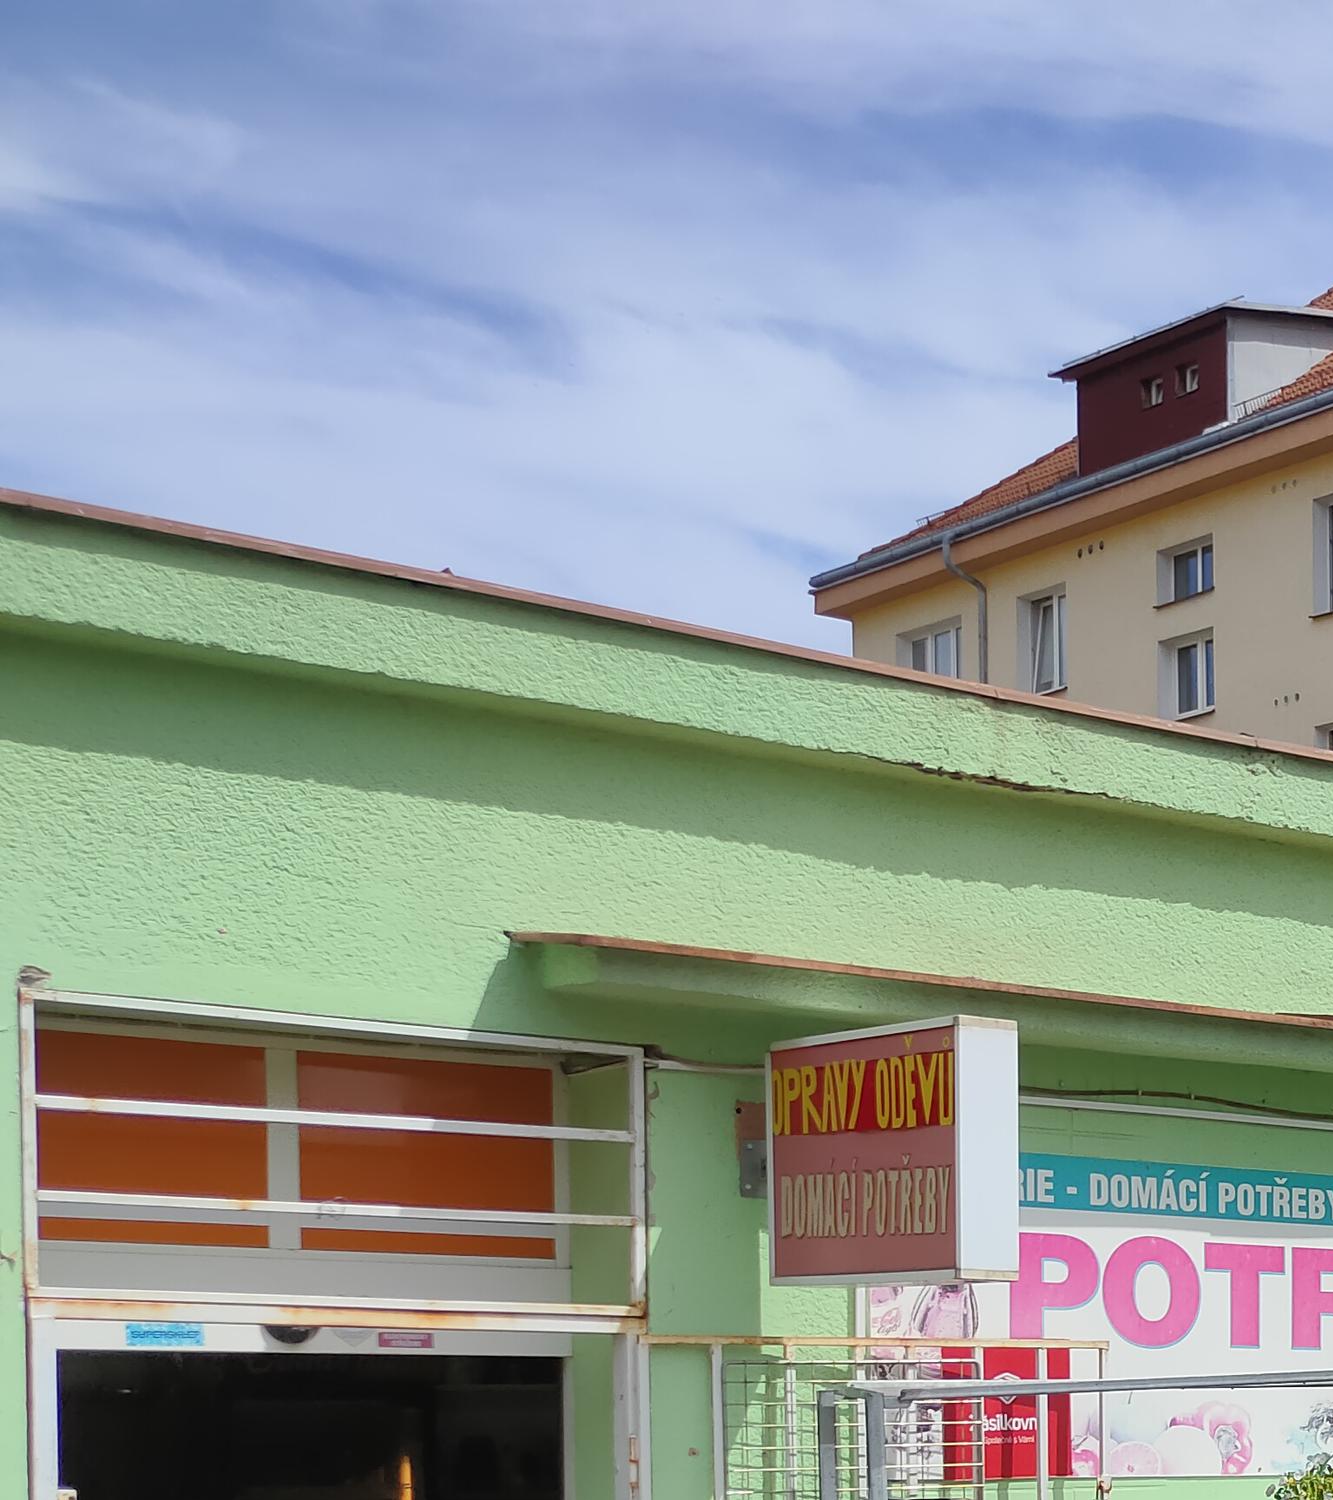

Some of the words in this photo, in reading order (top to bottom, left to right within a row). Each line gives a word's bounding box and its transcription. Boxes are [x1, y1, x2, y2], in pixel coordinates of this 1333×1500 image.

[772, 1059, 866, 1136] OPRAVY
[875, 1035, 954, 1129] ODĚVŮ
[781, 1157, 857, 1239] DOMÁCÍ
[863, 1154, 951, 1237] POTŘEBY
[1089, 1169, 1210, 1213] DOMÁCÍ
[968, 1413, 1038, 1432] ásilkovn
